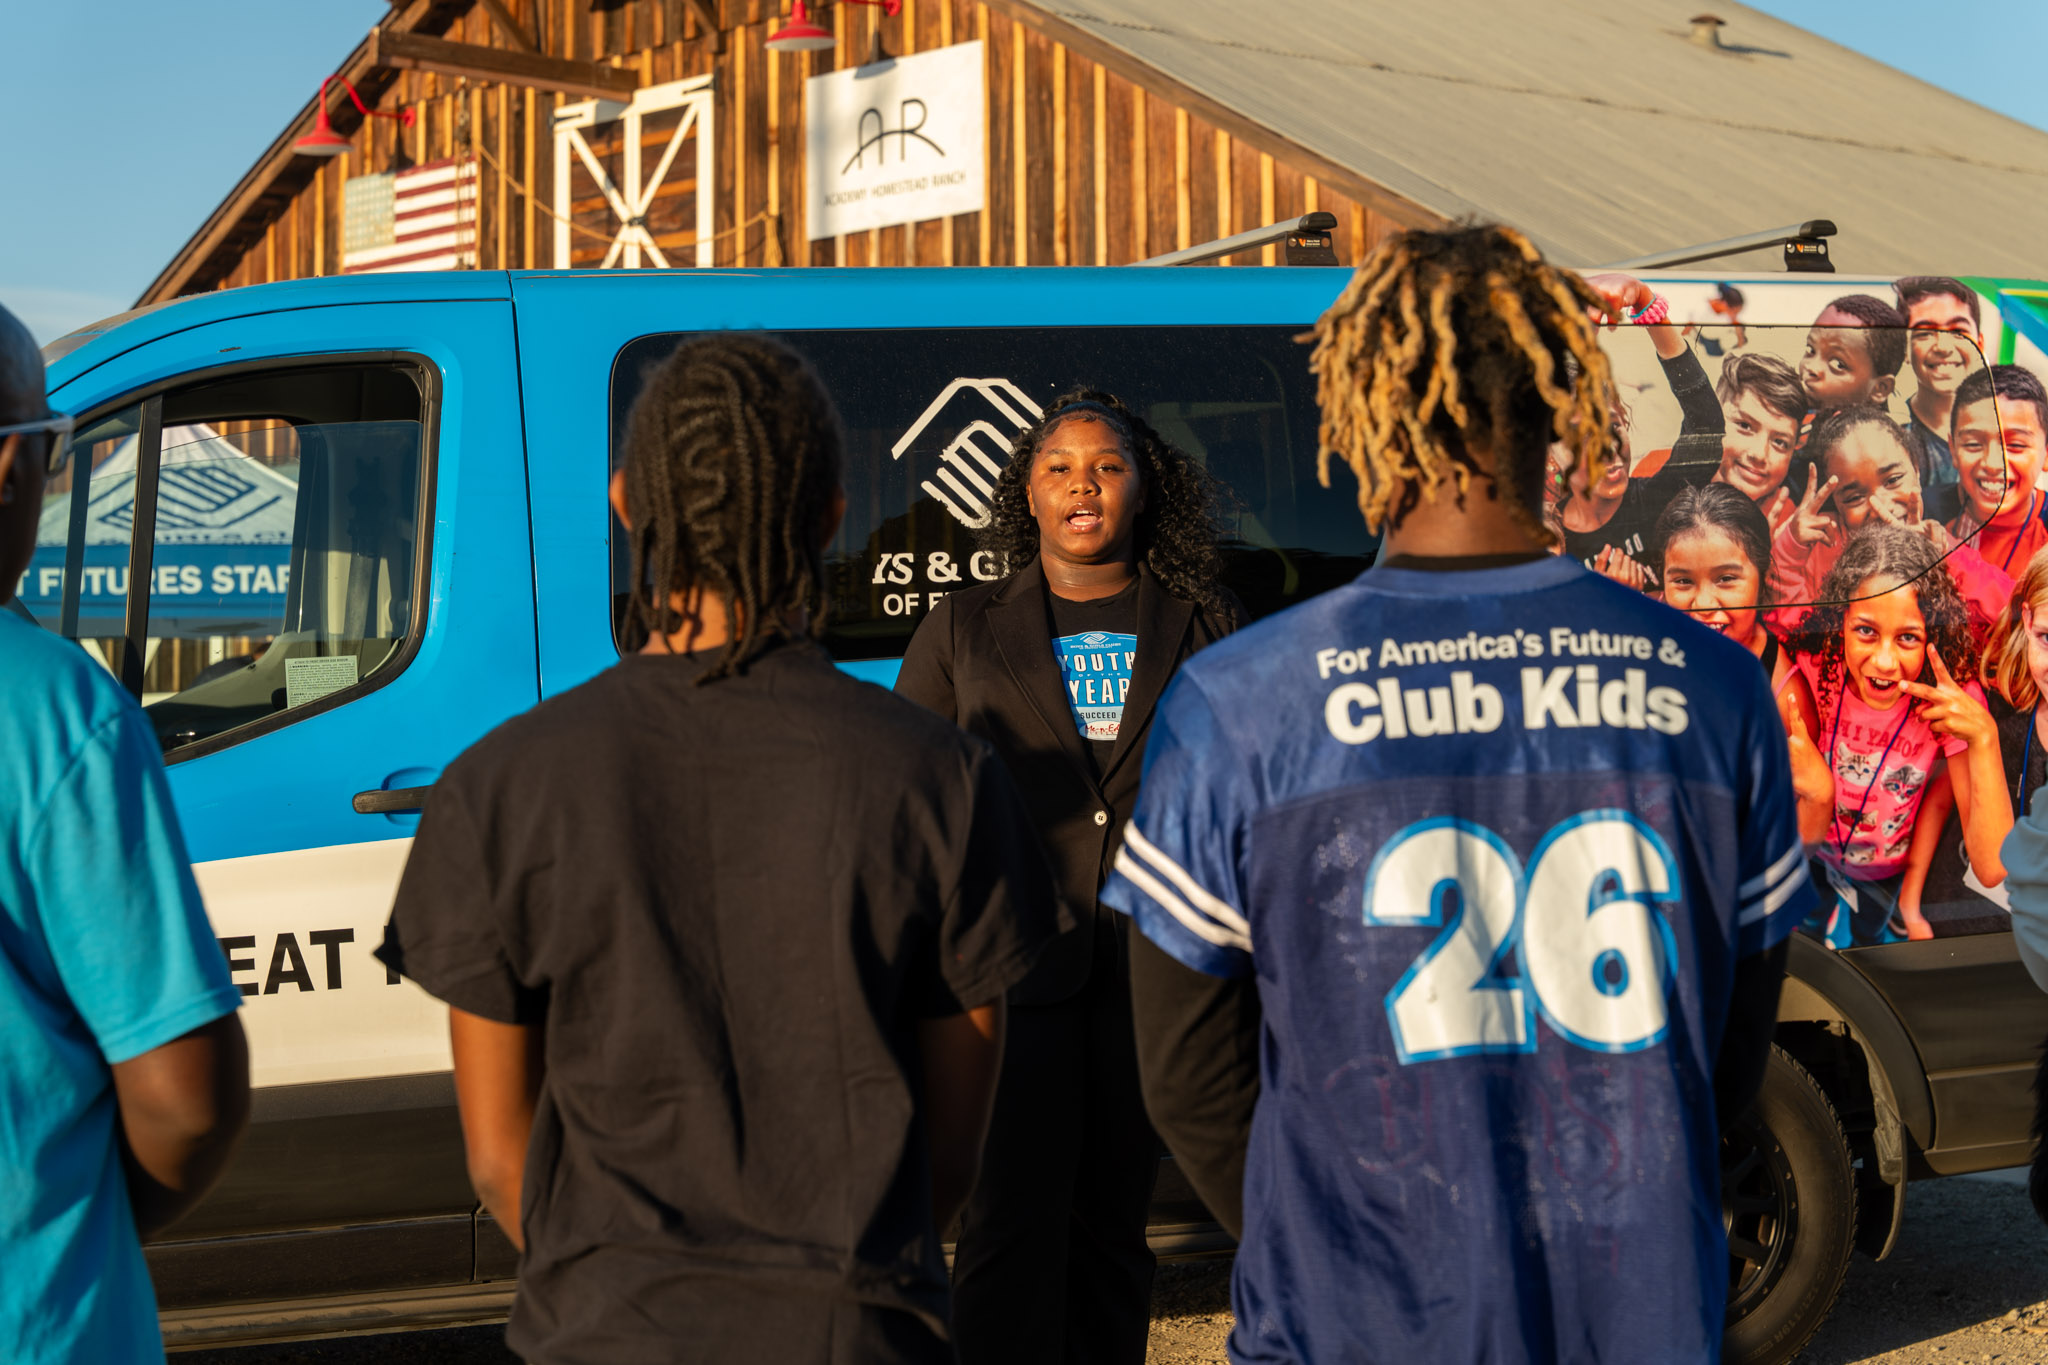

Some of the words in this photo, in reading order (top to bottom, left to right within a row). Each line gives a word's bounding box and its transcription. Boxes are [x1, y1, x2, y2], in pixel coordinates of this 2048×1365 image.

[871, 176, 929, 198] HOMESTEAD
[932, 169, 967, 188] RANCH
[926, 551, 962, 583] &
[883, 593, 920, 616] OF
[1056, 651, 1136, 672] YOUTH
[1317, 647, 1371, 679] For
[1379, 629, 1544, 668] America's
[1550, 627, 1653, 660] Future
[1657, 637, 1687, 668] &
[1068, 678, 1131, 704] YEAR
[1325, 671, 1504, 745] Club
[1520, 664, 1690, 736] Kids
[1080, 711, 1117, 719] SUCCEED
[1363, 807, 1682, 1066] 26
[216, 928, 355, 998] EAT
